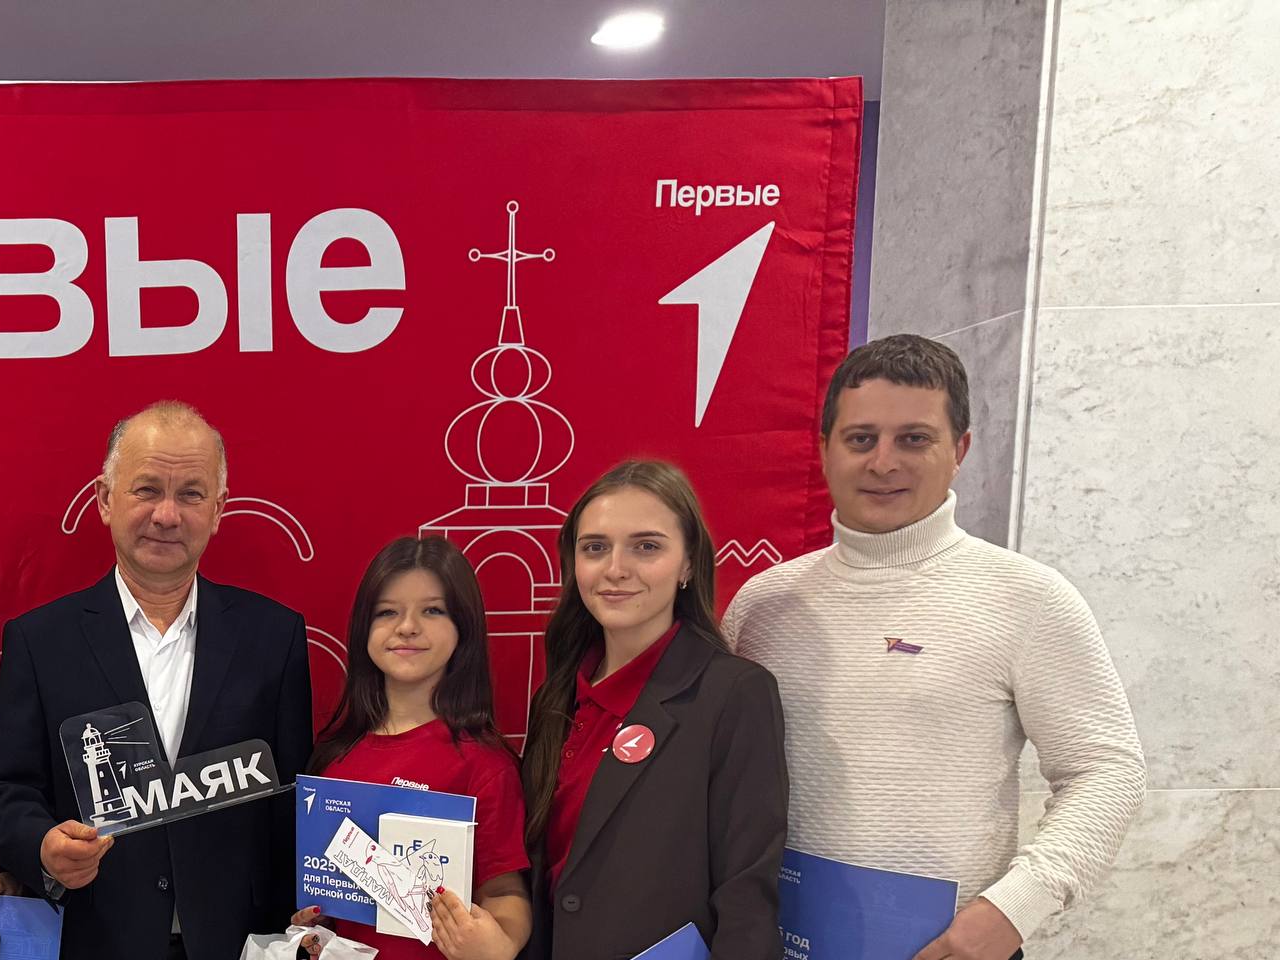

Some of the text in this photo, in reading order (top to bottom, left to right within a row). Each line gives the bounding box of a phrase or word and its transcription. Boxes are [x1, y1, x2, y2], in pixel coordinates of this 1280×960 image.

[655, 179, 780, 216] Первые
[122, 752, 271, 818] МАЯК
[391, 776, 429, 791] Первые
[325, 799, 351, 807] КУРСКАЯ
[325, 805, 351, 814] ОБЛАСТЬ
[303, 855, 336, 872] 2025
[303, 873, 321, 882] для
[334, 850, 394, 905] МАНДАТ
[303, 883, 375, 905] Курской облас
[786, 932, 810, 951] год
